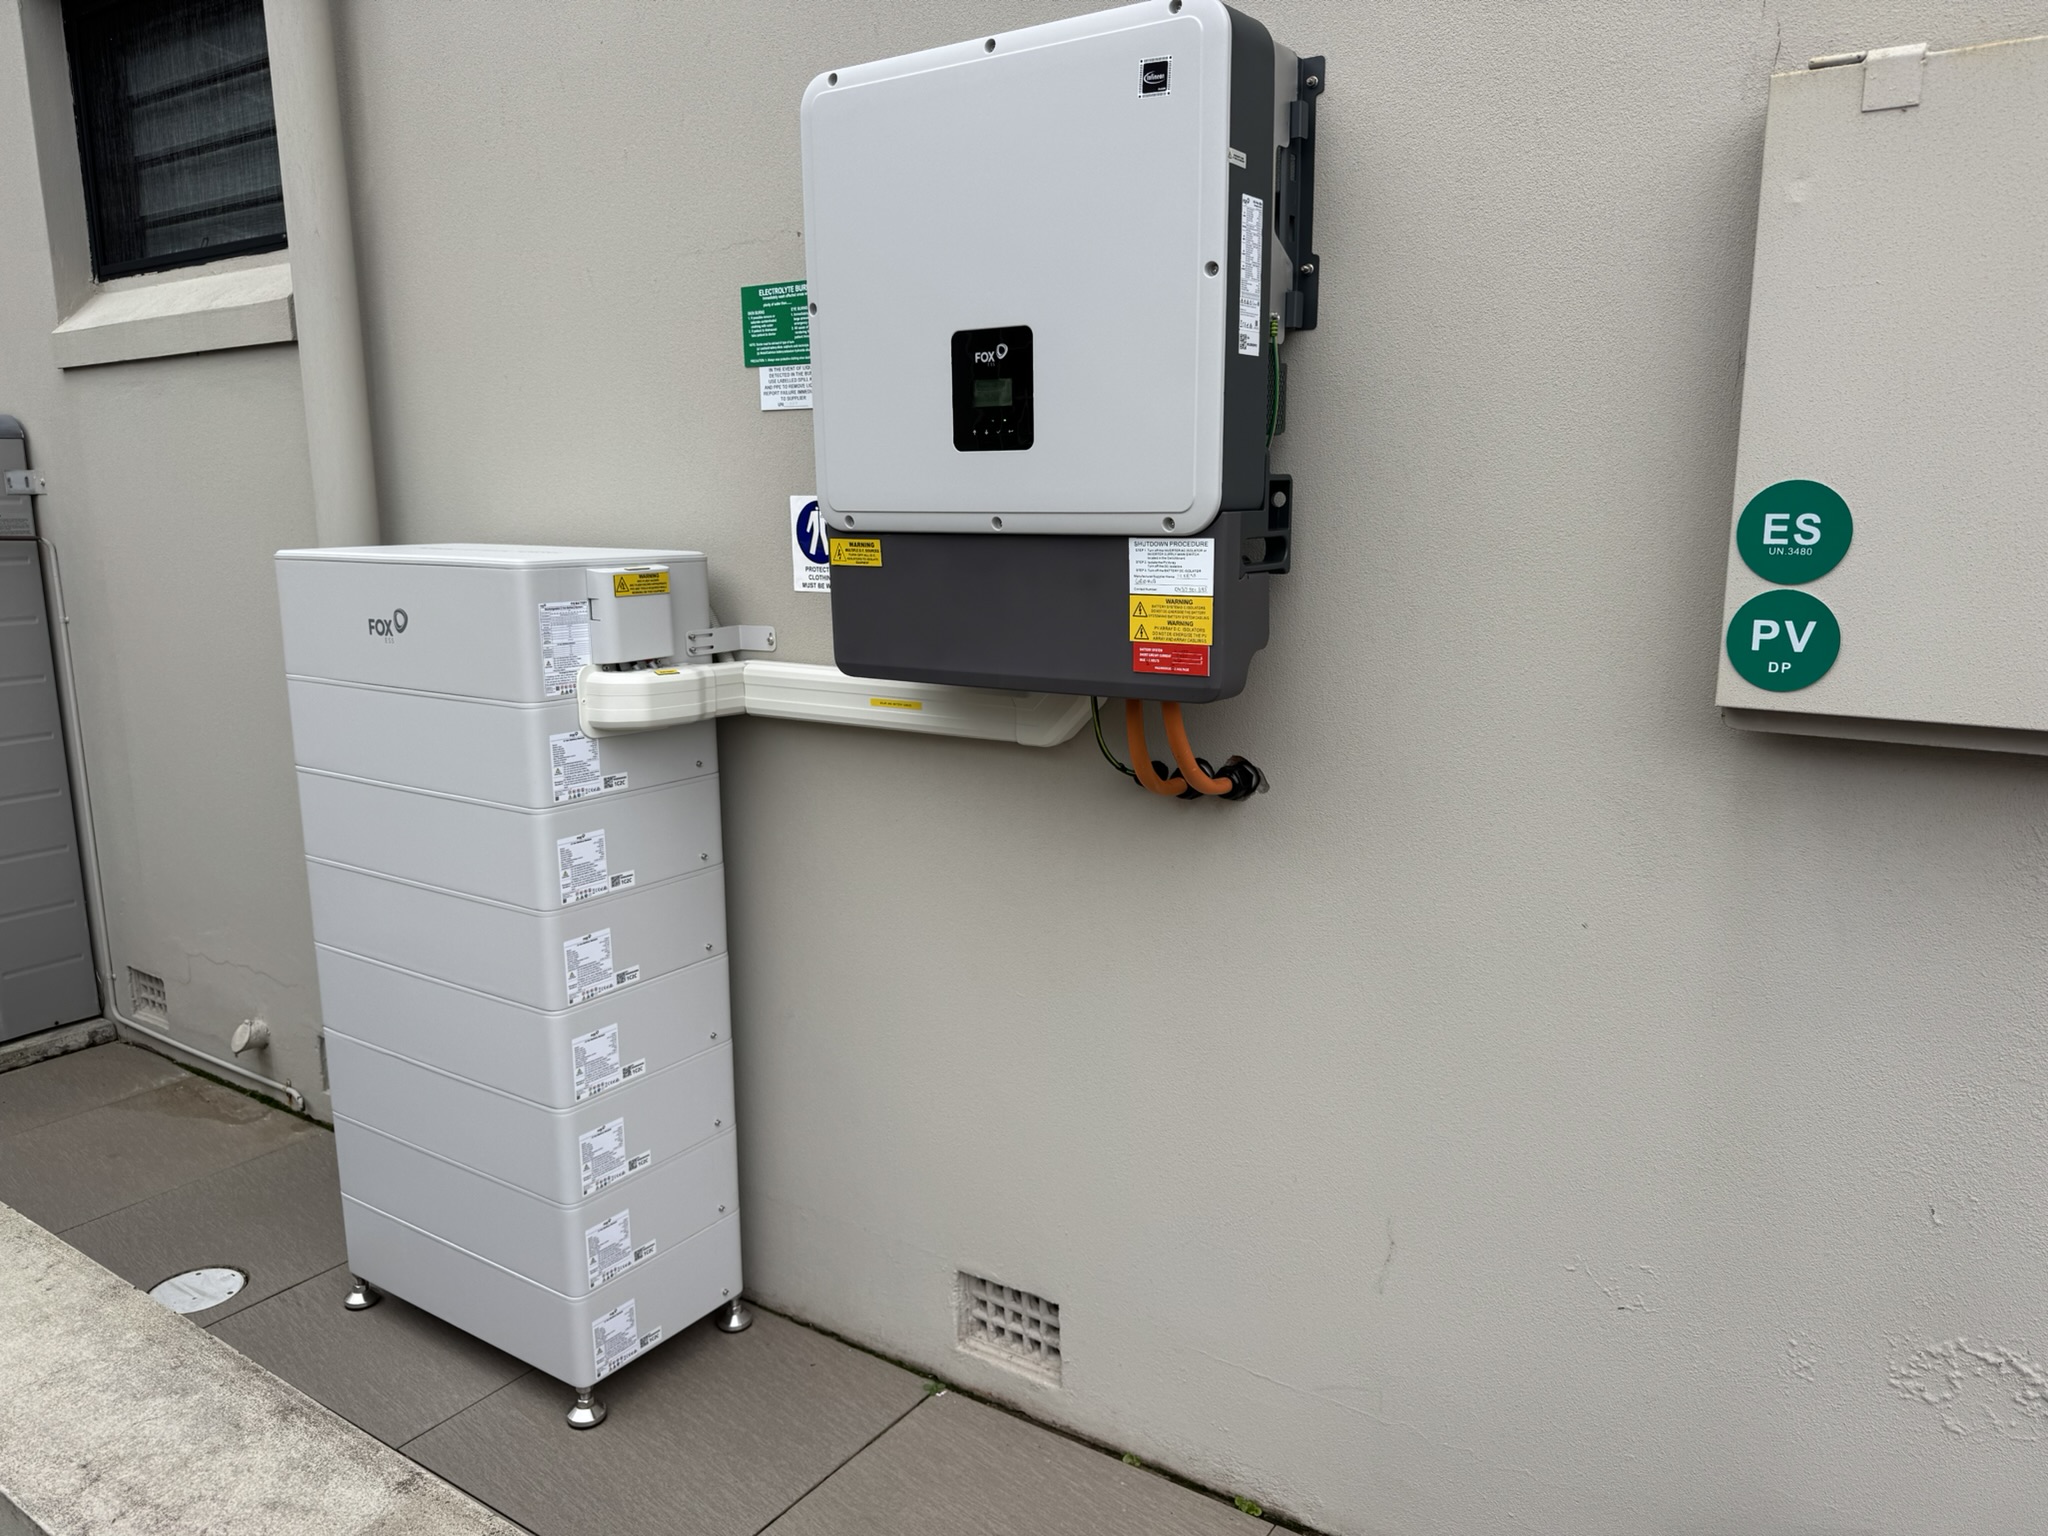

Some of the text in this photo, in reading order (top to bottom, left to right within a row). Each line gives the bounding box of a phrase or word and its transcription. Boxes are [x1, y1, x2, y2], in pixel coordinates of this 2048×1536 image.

[758, 286, 794, 297] ELECTROLYTE
[975, 351, 995, 364] FOX
[1762, 512, 1822, 546] ES
[1768, 546, 1812, 556] UN.3480
[368, 618, 394, 637] FOX
[1751, 619, 1817, 652] PV
[1768, 662, 1792, 673] DP
